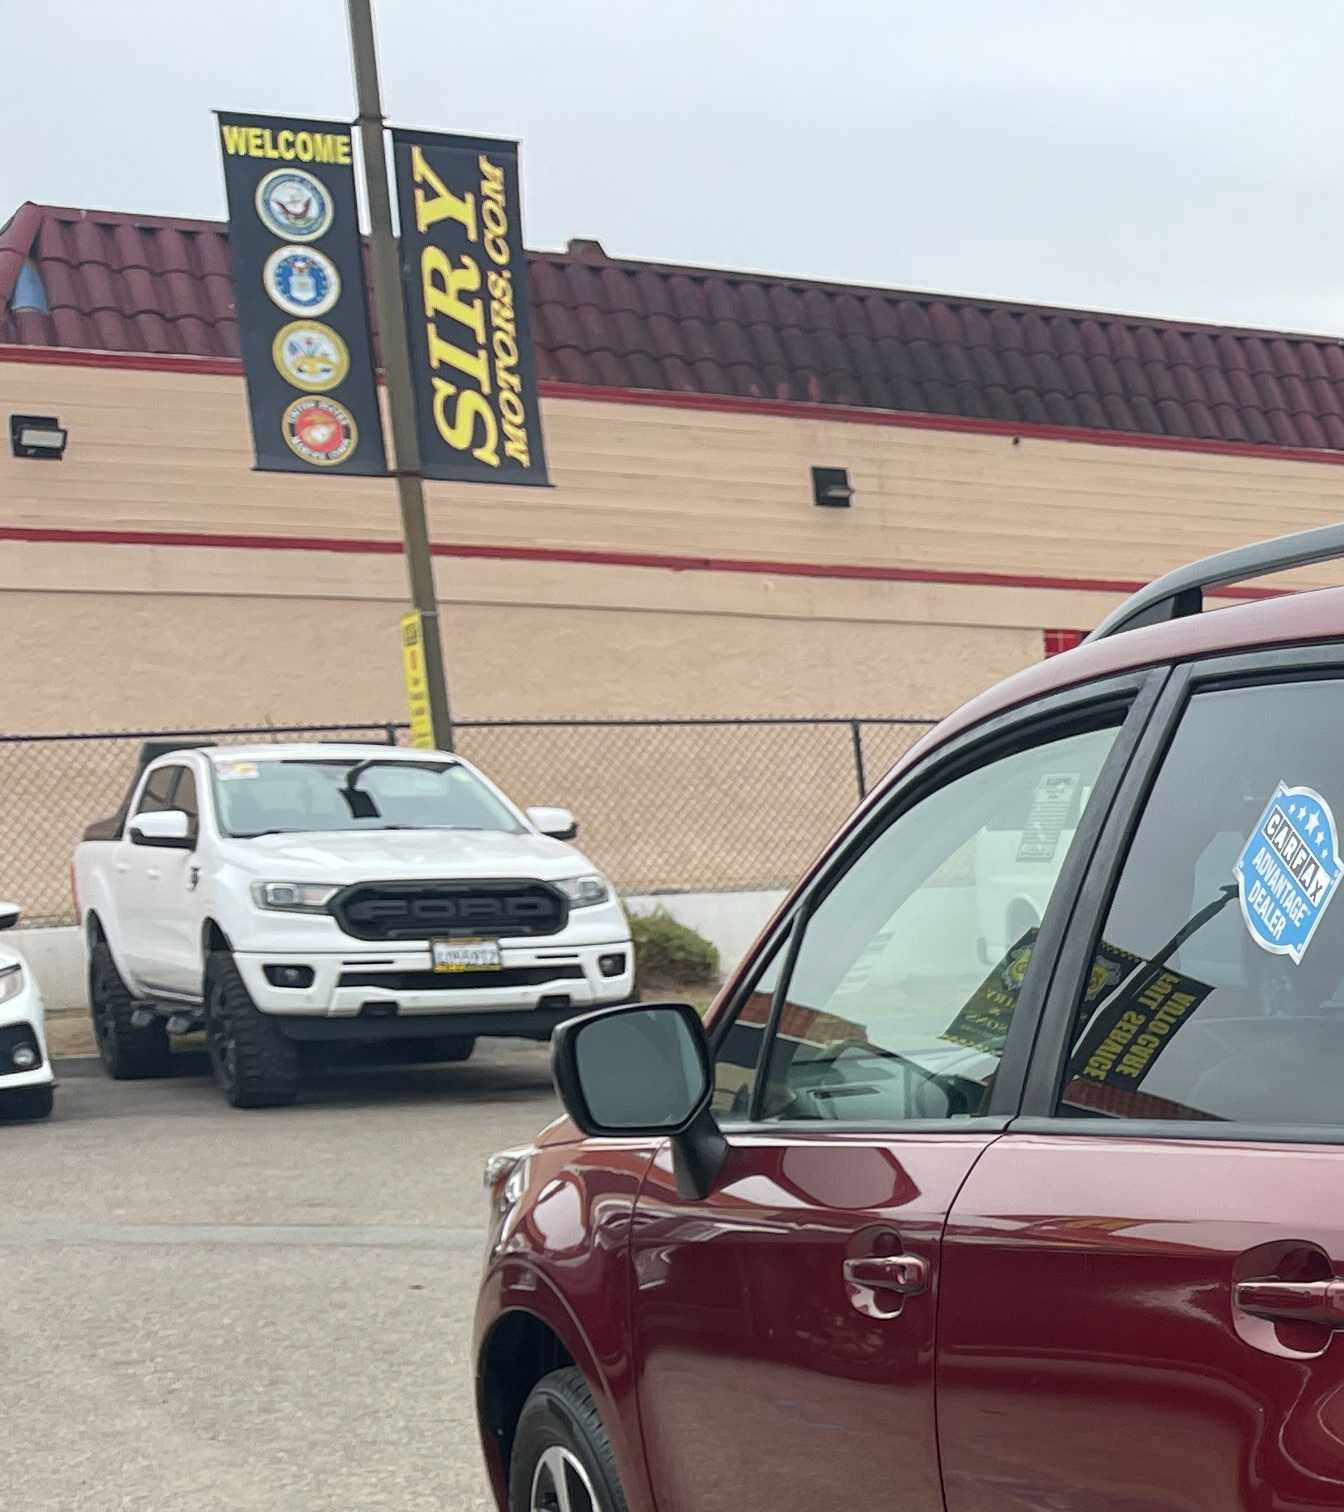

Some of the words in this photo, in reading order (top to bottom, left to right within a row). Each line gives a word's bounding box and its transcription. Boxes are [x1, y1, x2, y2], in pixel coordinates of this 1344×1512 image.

[222, 126, 352, 165] WELCOME
[411, 145, 500, 468] SIRY
[479, 155, 530, 469] MOTORS.COM
[1252, 847, 1309, 928] ADVANTAGE
[1266, 814, 1324, 904] CARFAX
[1248, 880, 1287, 941] DEALER
